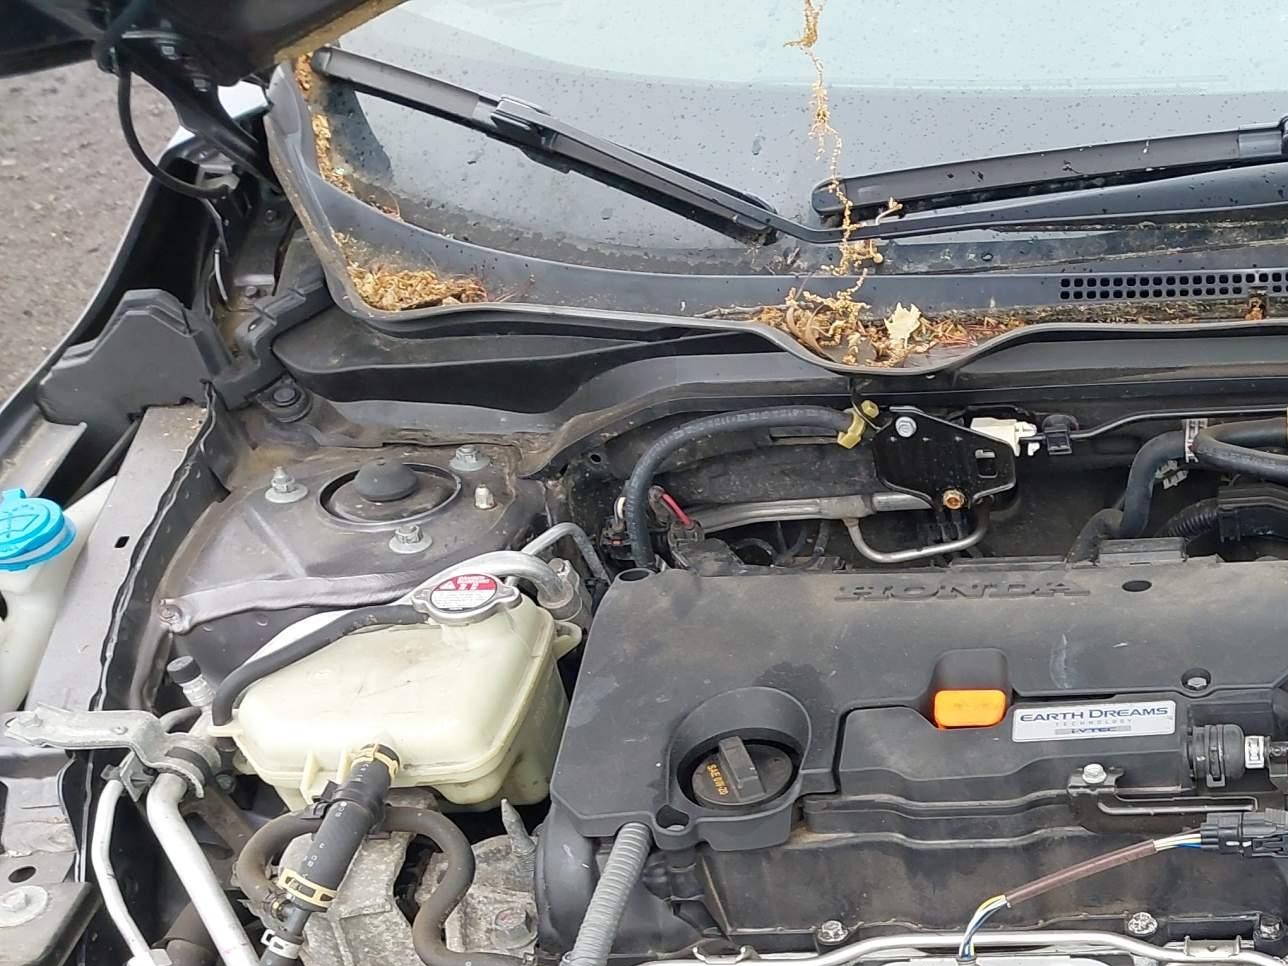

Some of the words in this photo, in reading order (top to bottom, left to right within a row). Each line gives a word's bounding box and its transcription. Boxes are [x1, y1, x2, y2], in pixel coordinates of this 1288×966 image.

[835, 583, 1090, 601] HONDA
[1020, 710, 1084, 722] EARTH
[1089, 706, 1169, 719] DREAMS
[707, 763, 720, 777] SAE
